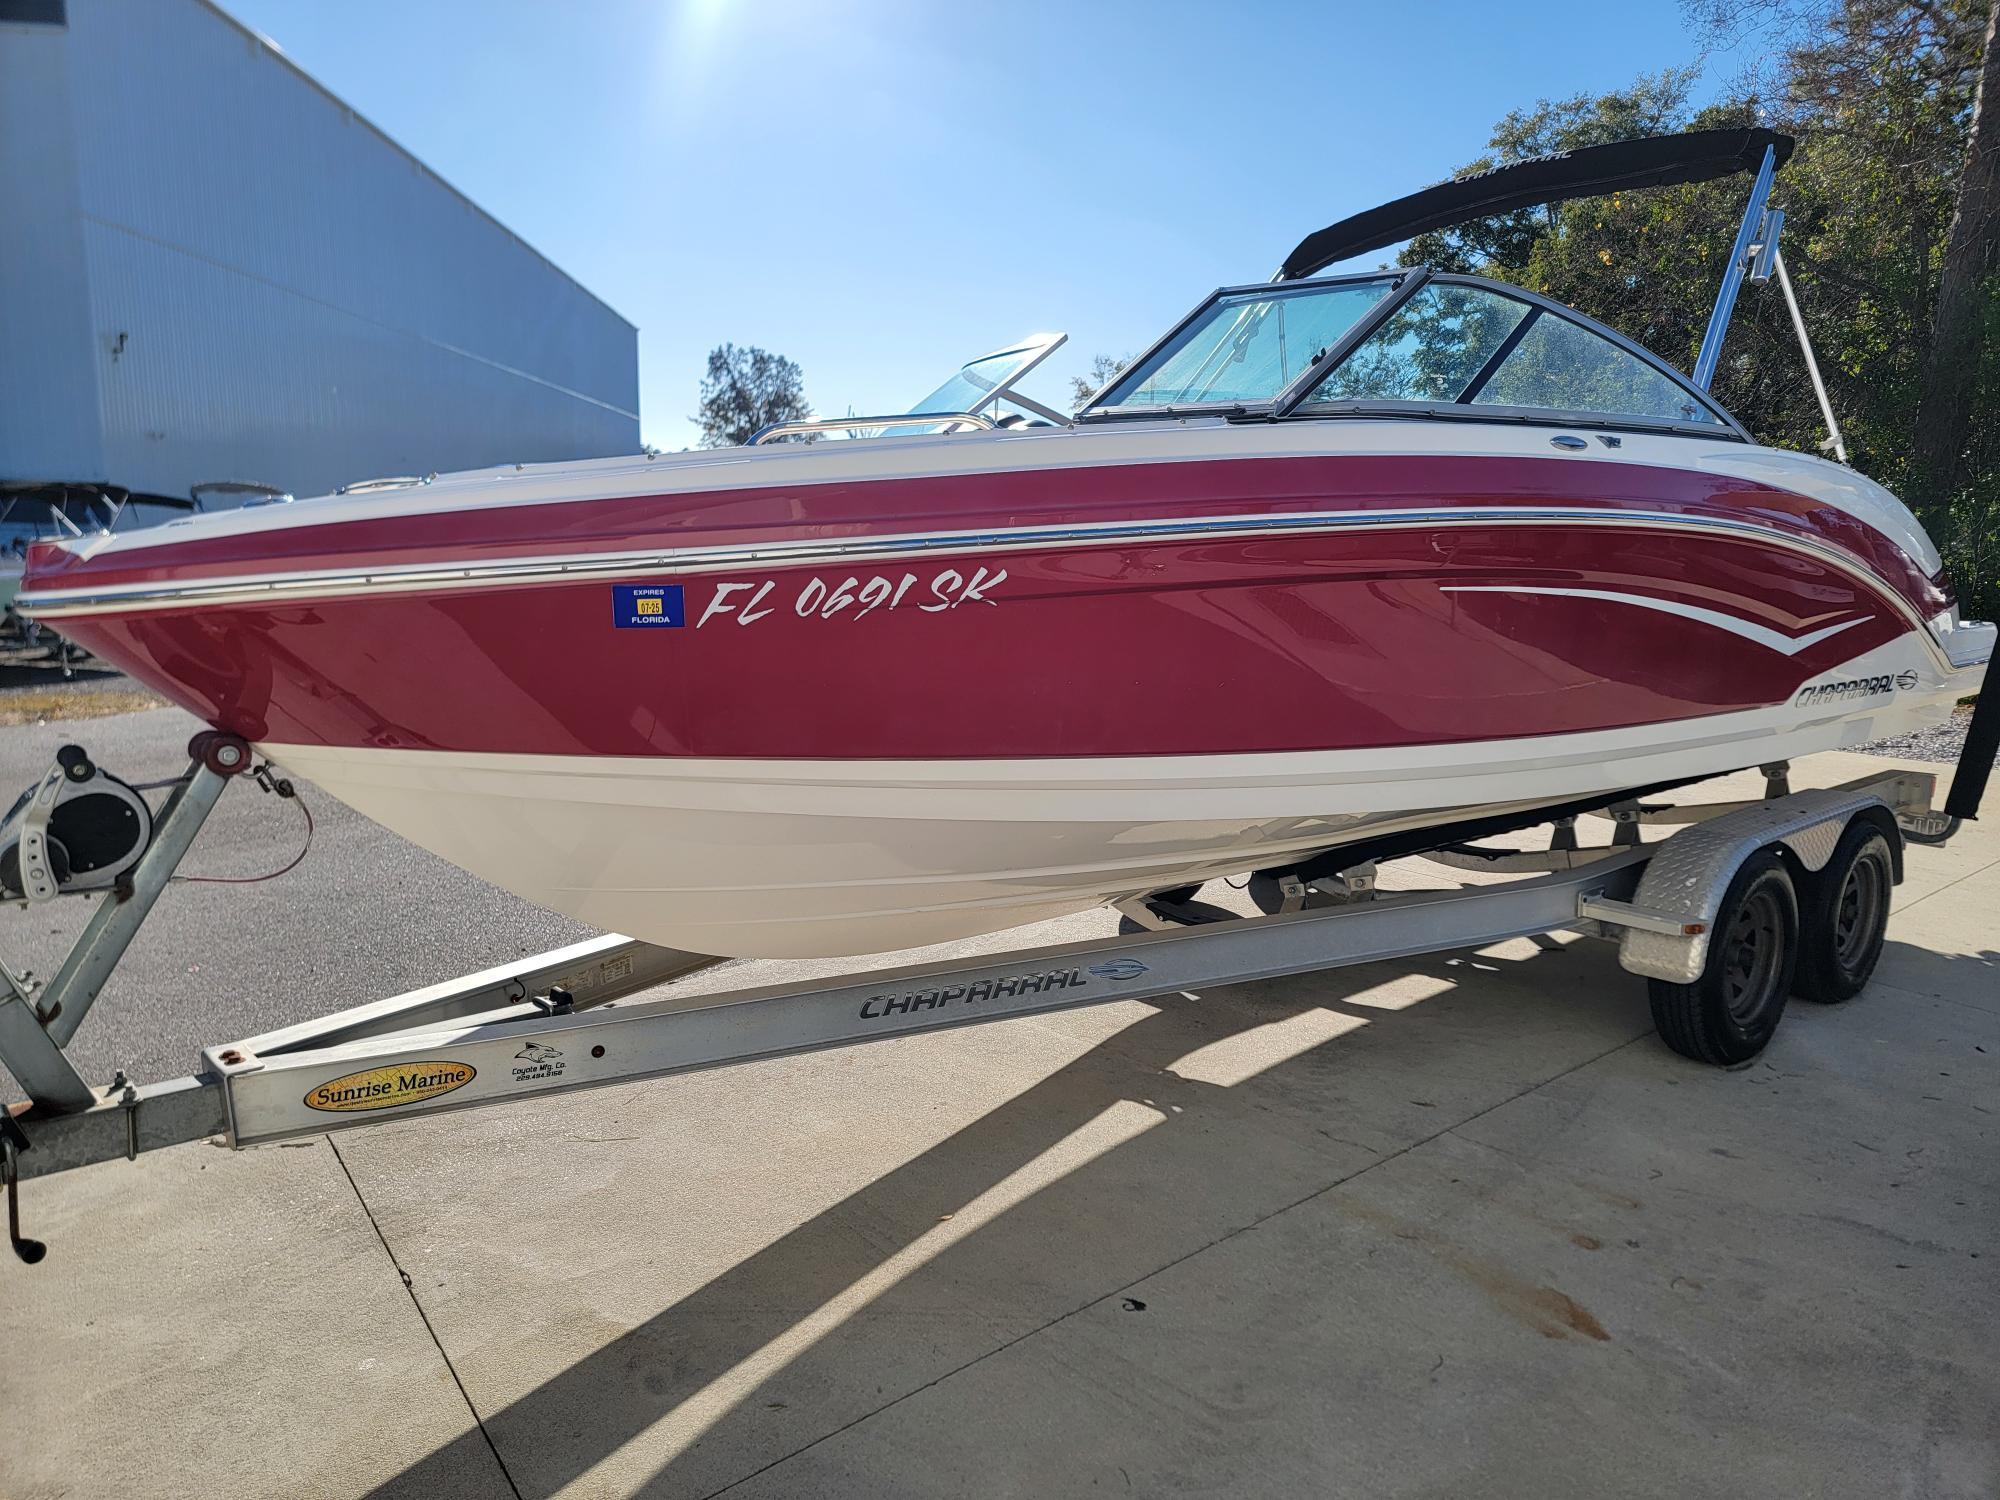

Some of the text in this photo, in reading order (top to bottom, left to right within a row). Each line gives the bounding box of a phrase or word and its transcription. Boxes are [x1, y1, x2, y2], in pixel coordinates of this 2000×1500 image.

[640, 602, 660, 614] 07-25
[696, 567, 1008, 629] FL 0691 SK
[631, 616, 671, 624] FLORIDA
[1795, 673, 1896, 708] CHAPARRAL
[859, 966, 1087, 1019] CHAPARRAL
[512, 1061, 567, 1076] Coyote Mfg. Co.
[317, 1082, 392, 1105] Sunrise
[398, 1069, 466, 1092] Marine
